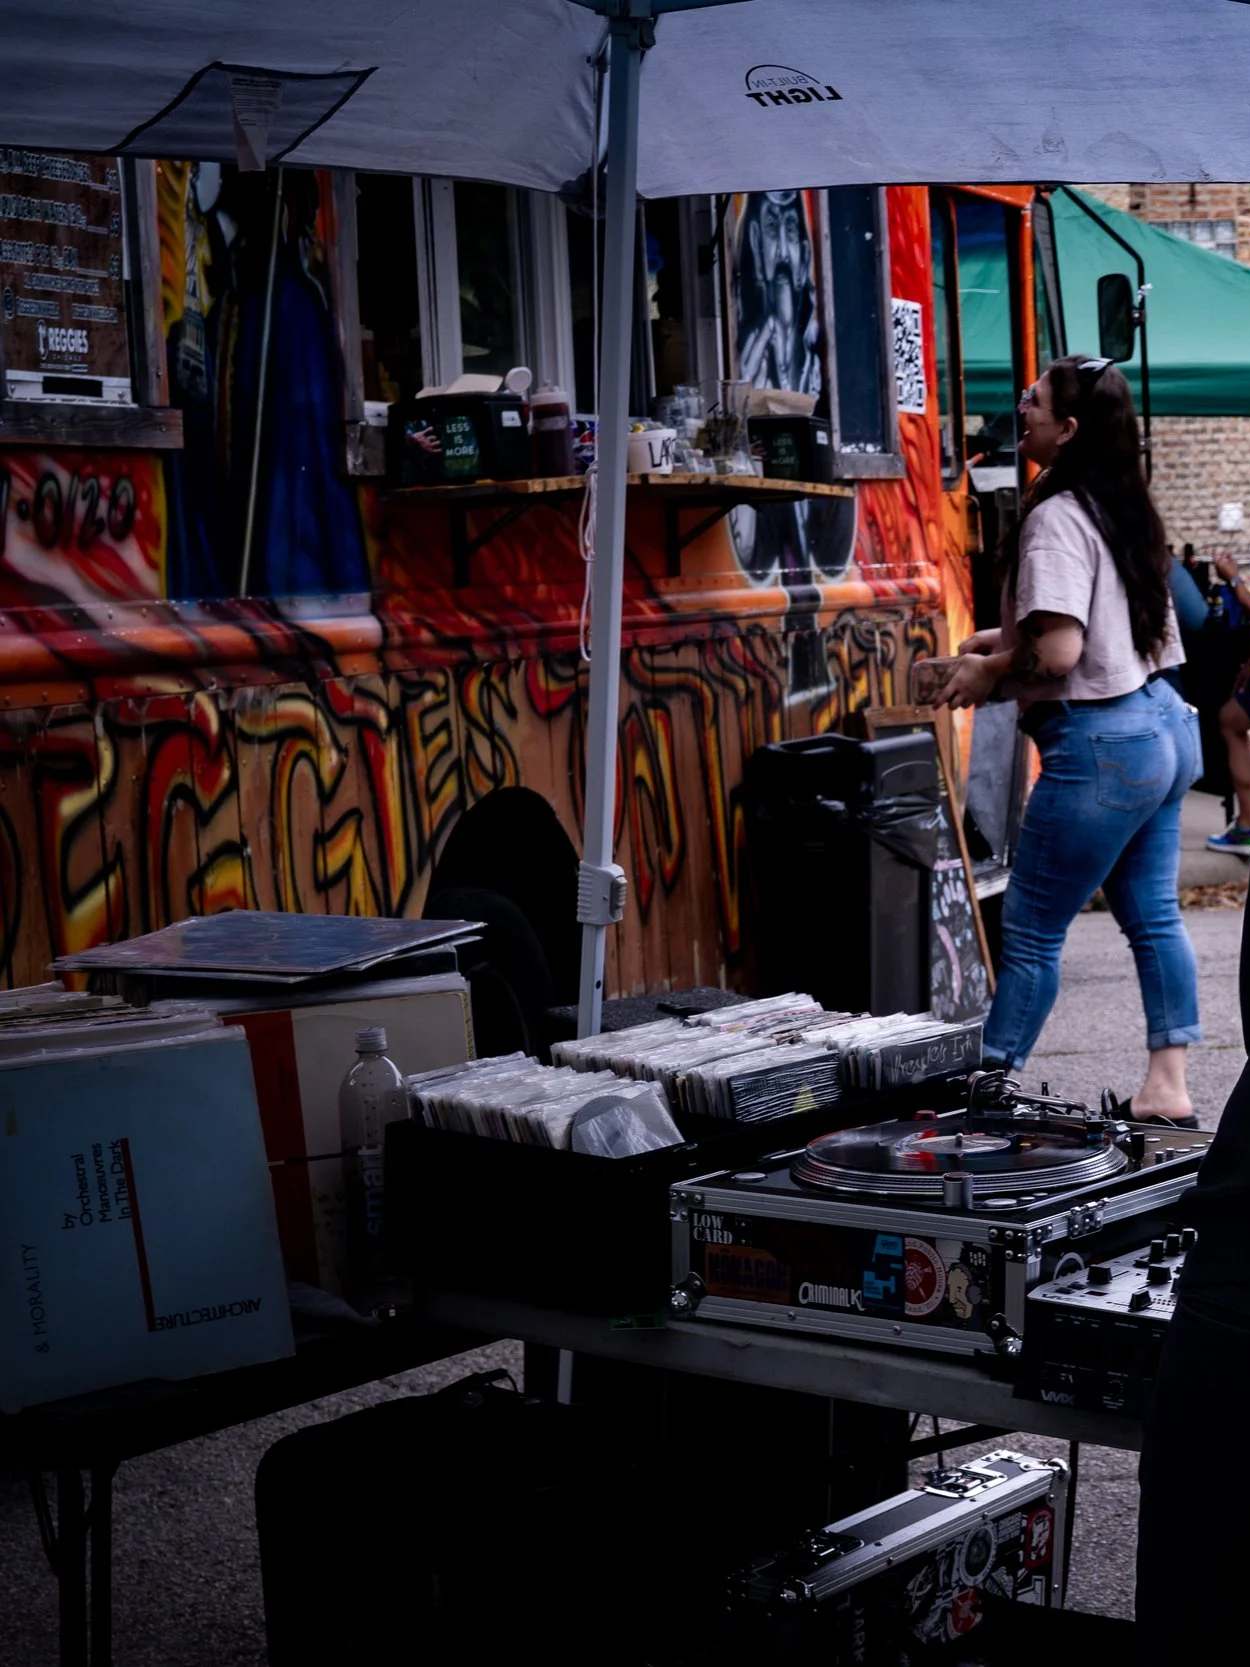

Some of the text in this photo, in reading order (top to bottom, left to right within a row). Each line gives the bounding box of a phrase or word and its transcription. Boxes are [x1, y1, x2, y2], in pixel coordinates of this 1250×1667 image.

[48, 327, 88, 353] REGGIES
[446, 424, 470, 433] LESS
[453, 435, 463, 444] IS
[445, 446, 474, 457] MORE
[71, 1153, 93, 1226] Orchestral
[108, 1140, 131, 1220] In The Dark
[357, 1144, 385, 1236] smart
[62, 1212, 78, 1230] by
[692, 1212, 724, 1229] LOW
[692, 1226, 734, 1245] CARD
[21, 1243, 49, 1354] & MORALITY
[154, 1298, 262, 1332] ARCHITECTURE
